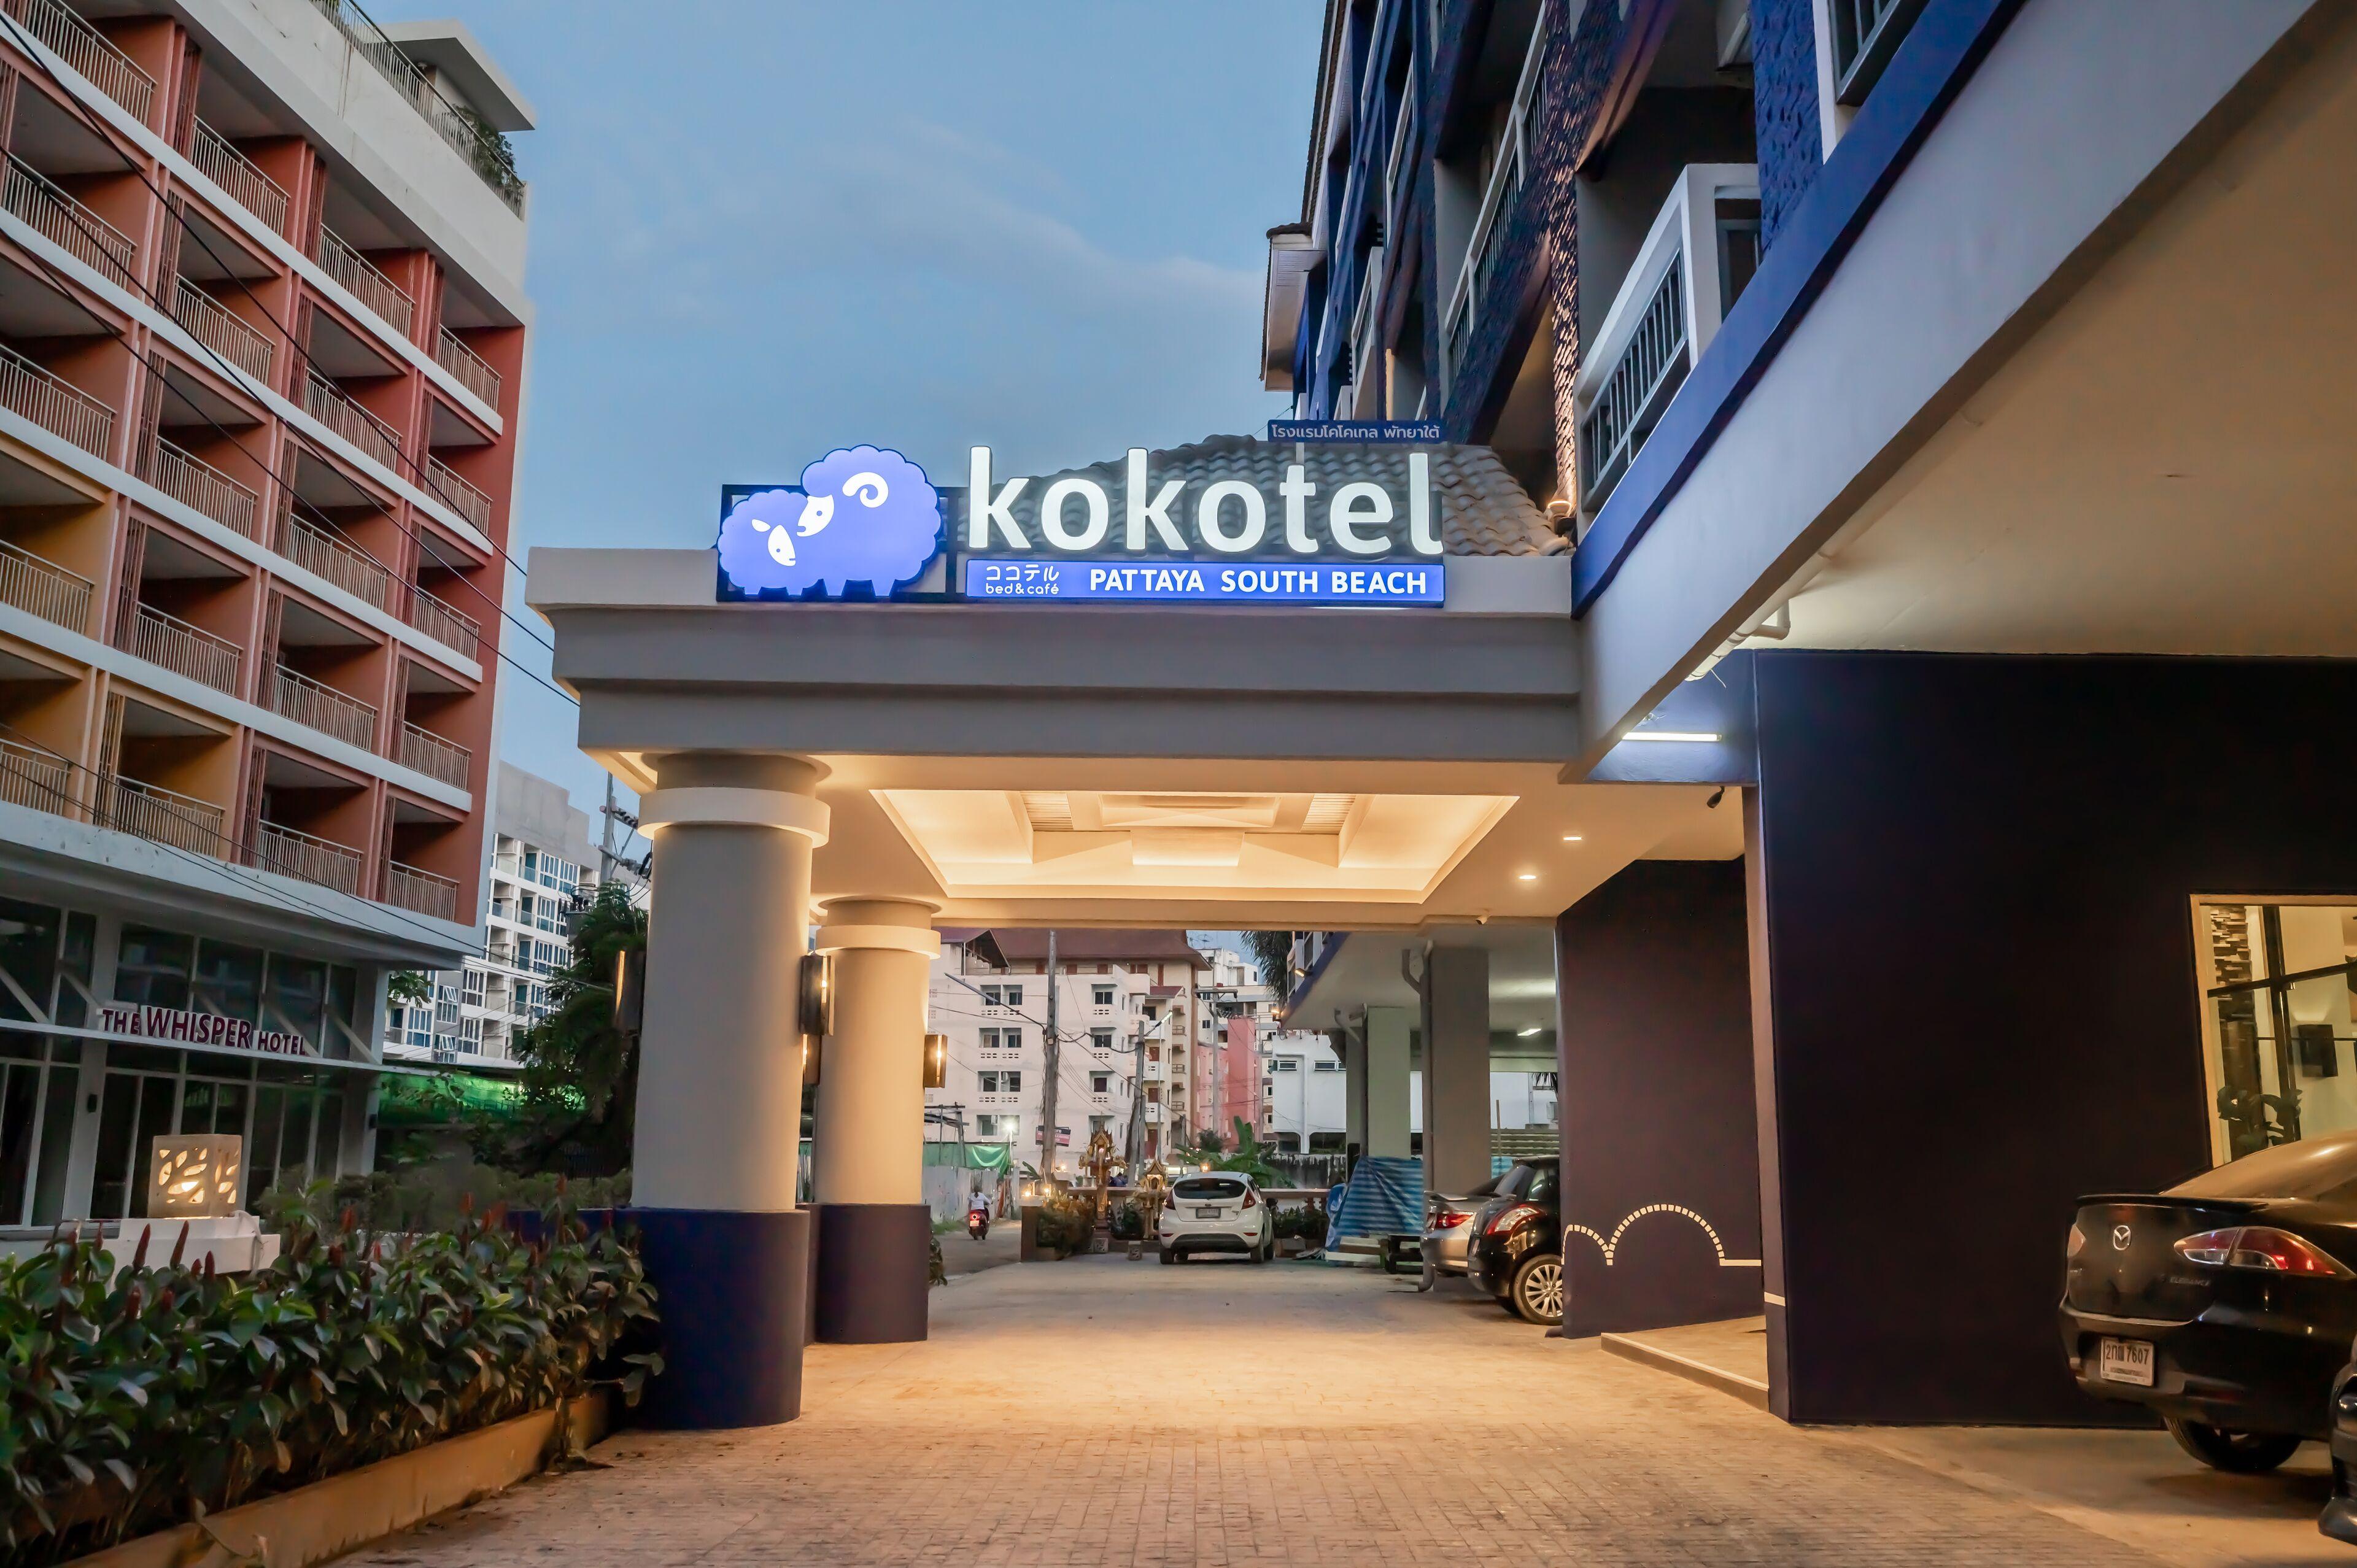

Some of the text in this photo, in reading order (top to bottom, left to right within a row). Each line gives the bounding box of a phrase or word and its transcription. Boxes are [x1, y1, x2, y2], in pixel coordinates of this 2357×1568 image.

[1271, 424, 1440, 438] โรงแรมโคโคเทล พัทยาใต้
[969, 446, 1444, 554] kokotel
[986, 564, 1059, 582] ココテル
[1090, 569, 1426, 594] PATTAYA SOUTH BEACH
[102, 1006, 306, 1056] THE WHISPER HOTEL
